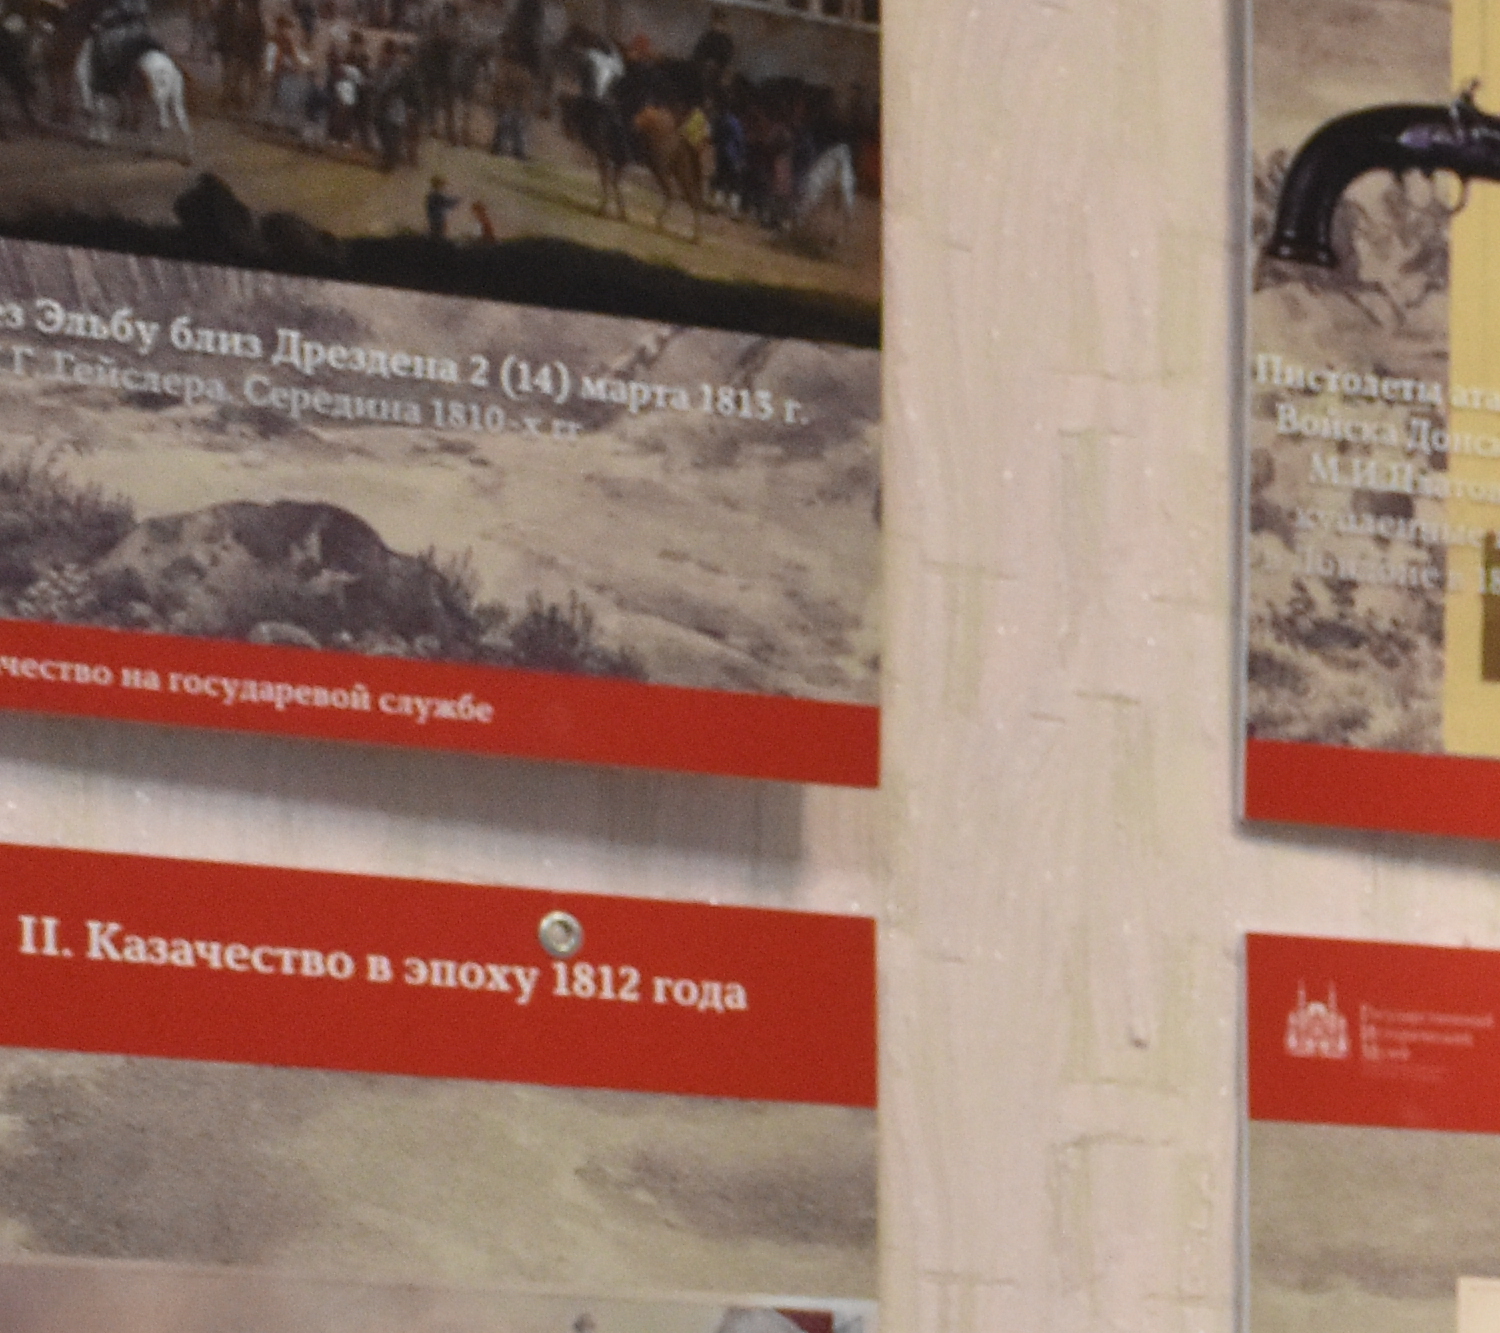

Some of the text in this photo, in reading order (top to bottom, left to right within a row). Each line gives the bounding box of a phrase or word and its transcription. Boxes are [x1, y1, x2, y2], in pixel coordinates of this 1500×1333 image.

[36, 298, 160, 355] Эльбу
[170, 316, 263, 359] близ
[272, 327, 459, 382] Дрездена
[470, 354, 488, 387] 2
[501, 354, 571, 403] (14)
[582, 375, 690, 414] марта
[784, 398, 811, 426] г.
[1256, 352, 1442, 405] Пистолеты
[243, 373, 422, 426] Середина
[1276, 402, 1398, 447] Войска
[121, 663, 161, 691] на
[168, 670, 371, 712] государевой
[378, 693, 494, 724] службе
[86, 919, 356, 980] Казачество
[366, 953, 394, 983] в
[403, 956, 541, 1006] эпоху
[552, 960, 642, 1003] 1812
[652, 975, 748, 1014] года
